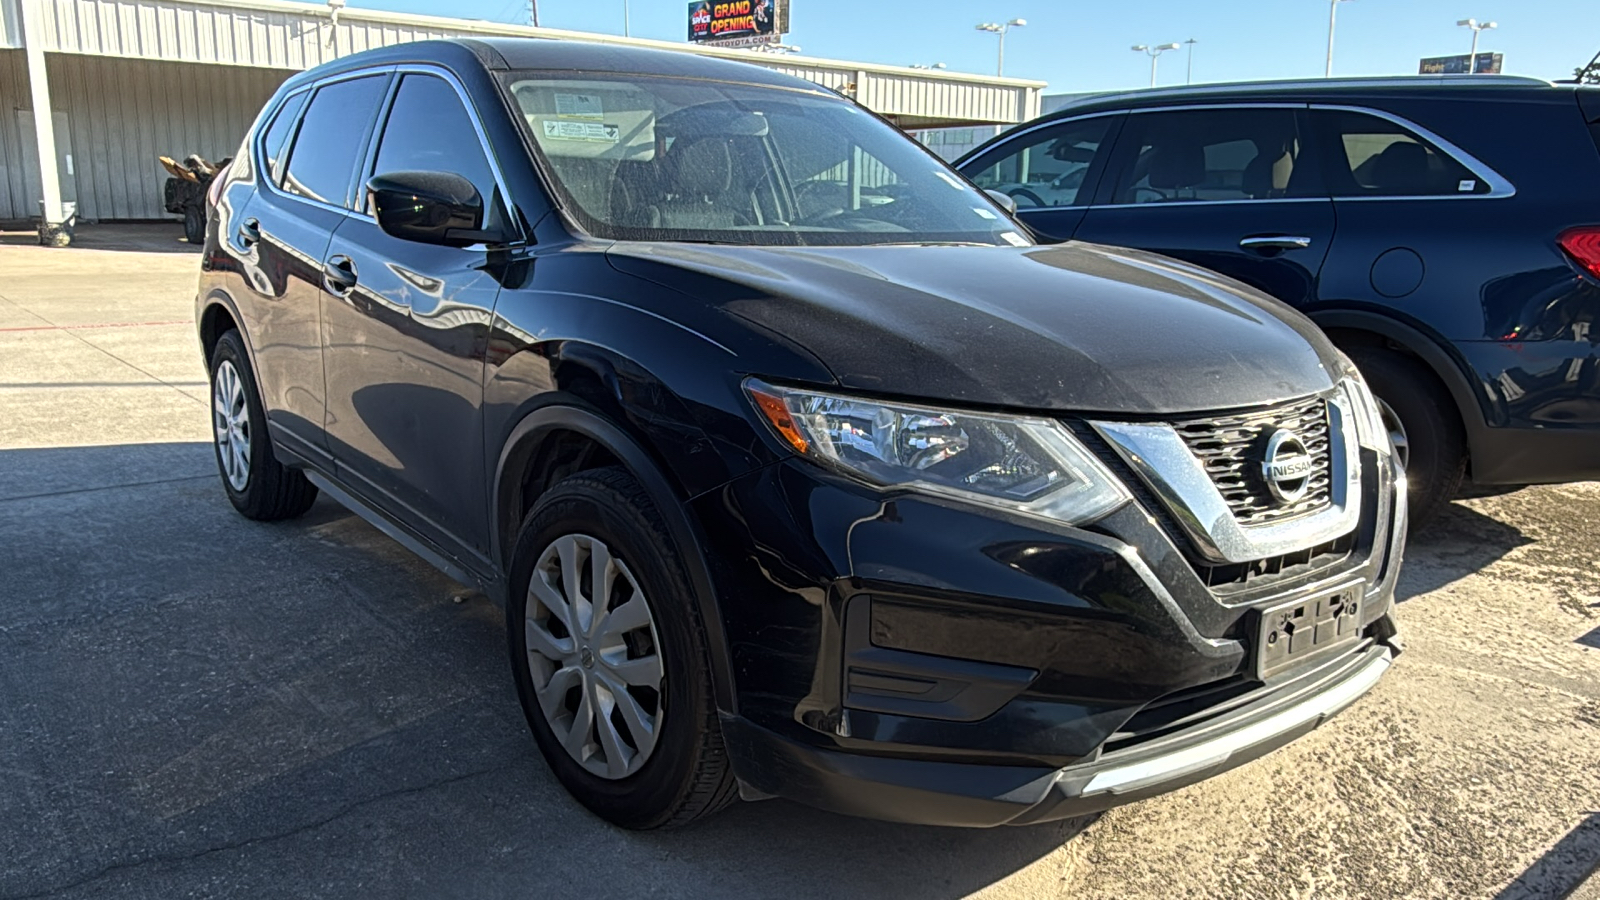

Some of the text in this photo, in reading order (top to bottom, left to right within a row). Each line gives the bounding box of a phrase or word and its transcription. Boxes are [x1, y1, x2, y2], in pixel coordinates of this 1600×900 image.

[714, 0, 750, 18] GRAND
[692, 14, 711, 25] SPACE
[694, 23, 708, 32] CITY
[710, 15, 753, 33] OPENING
[1273, 460, 1312, 478] NISSAN
